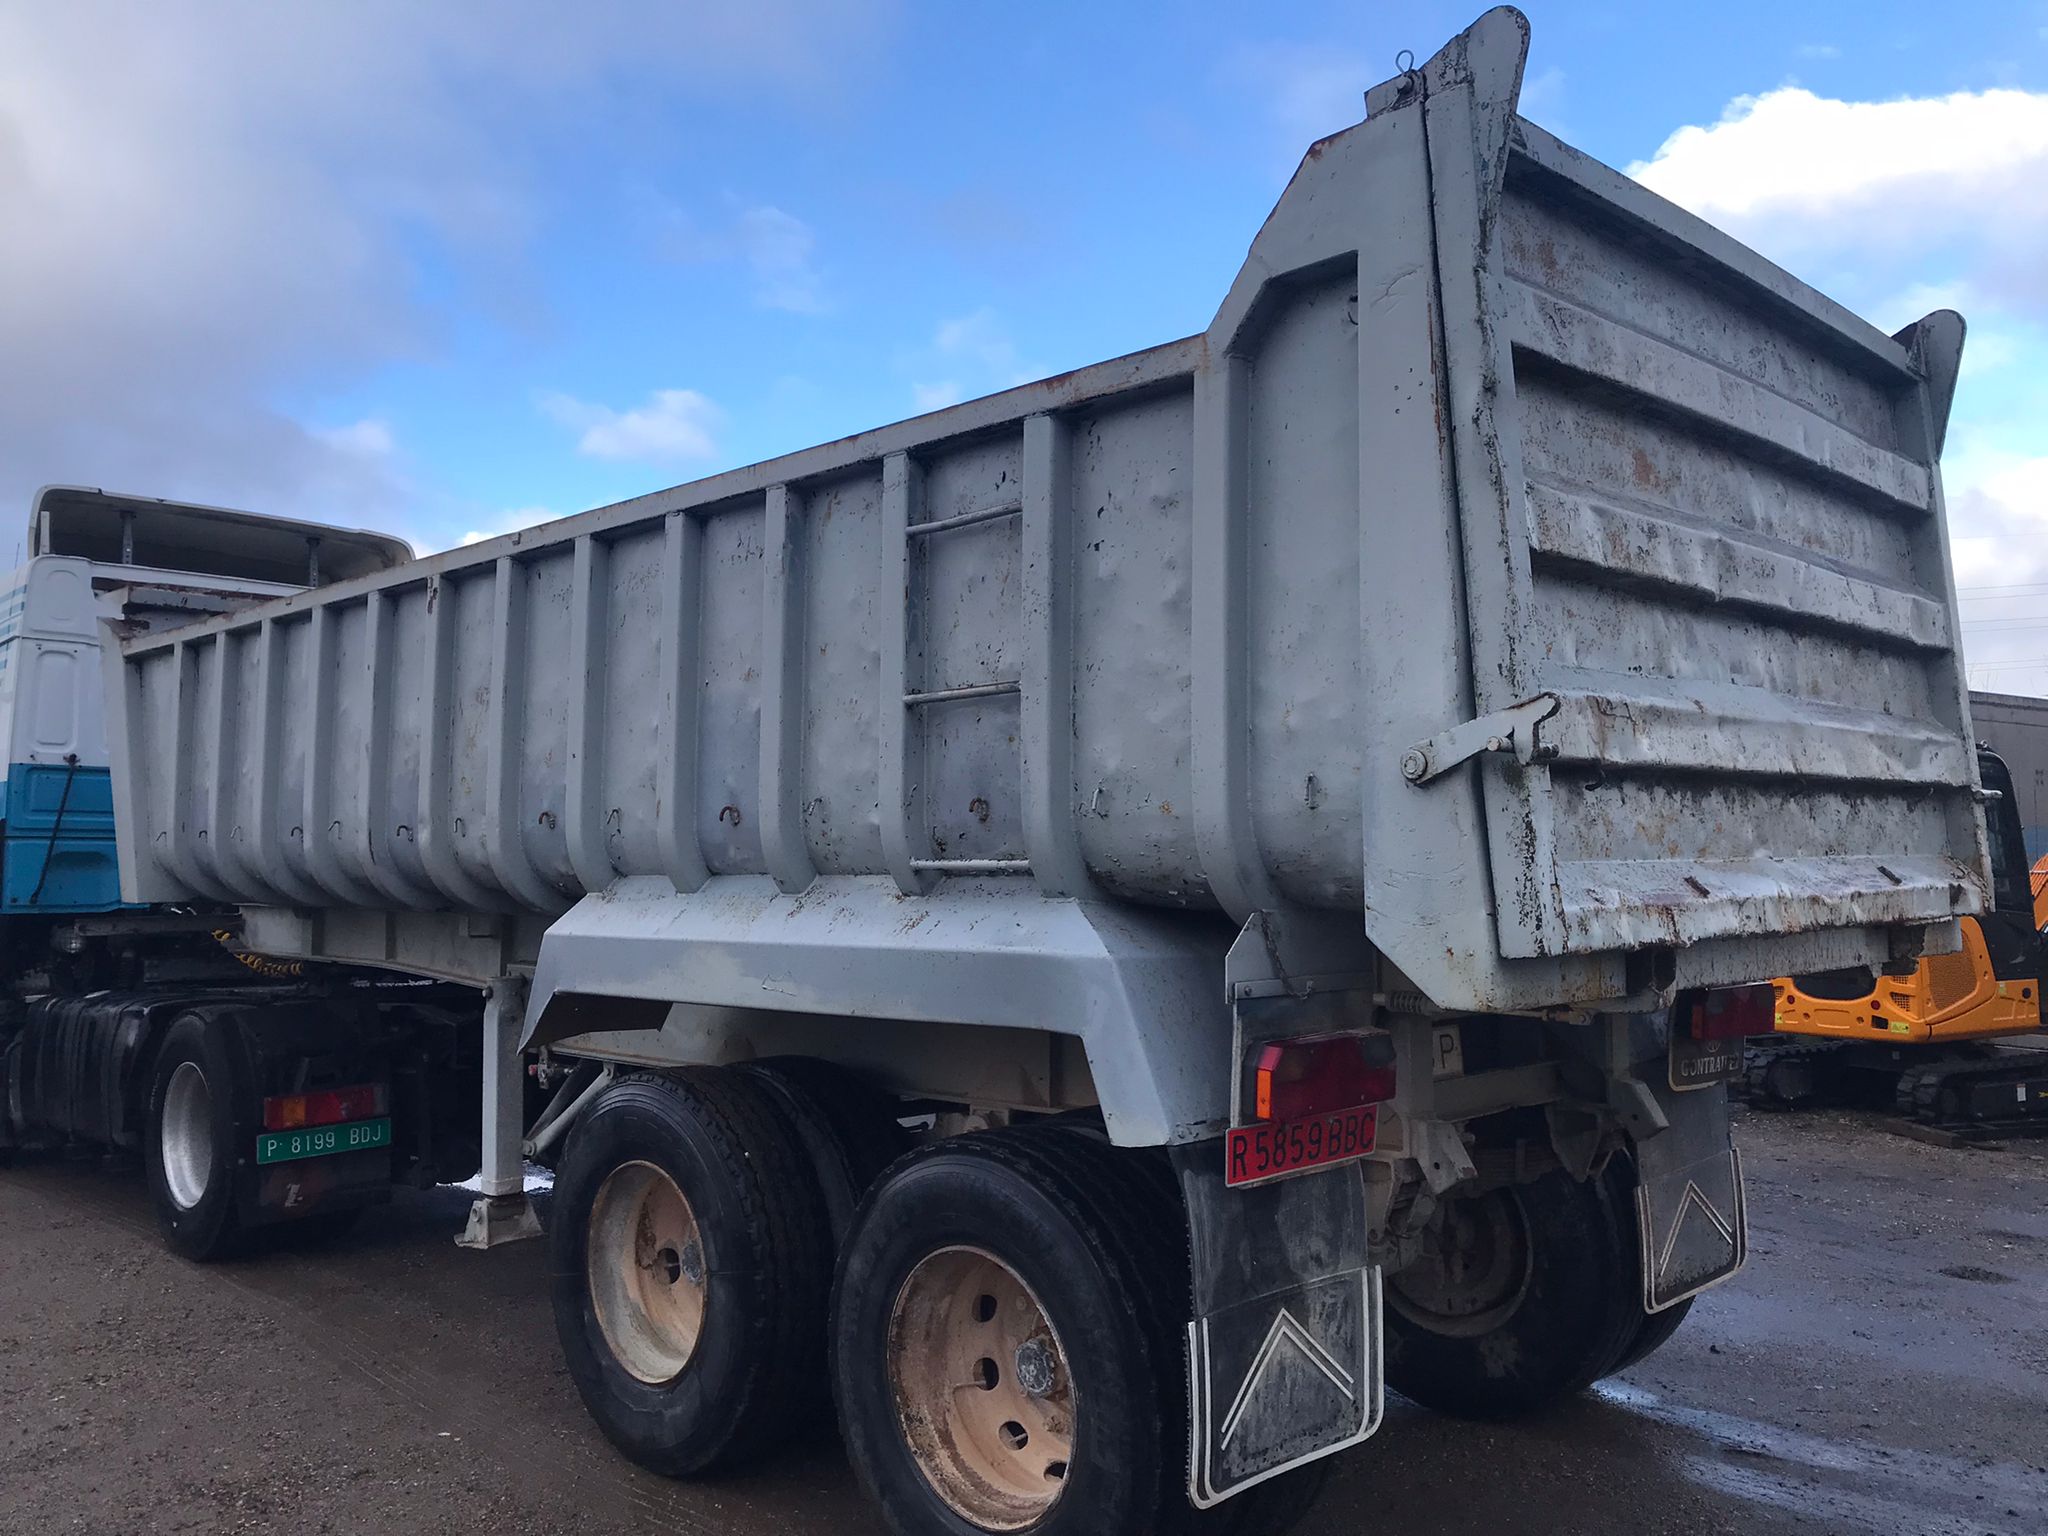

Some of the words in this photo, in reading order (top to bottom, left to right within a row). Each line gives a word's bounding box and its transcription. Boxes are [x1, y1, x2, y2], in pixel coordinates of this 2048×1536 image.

[1432, 1034, 1454, 1069] P
[291, 1131, 335, 1153] 8199
[350, 1125, 381, 1144] BDJ
[1232, 1135, 1247, 1178] R
[1256, 1121, 1322, 1171] 5859
[1328, 1111, 1374, 1156] BBC
